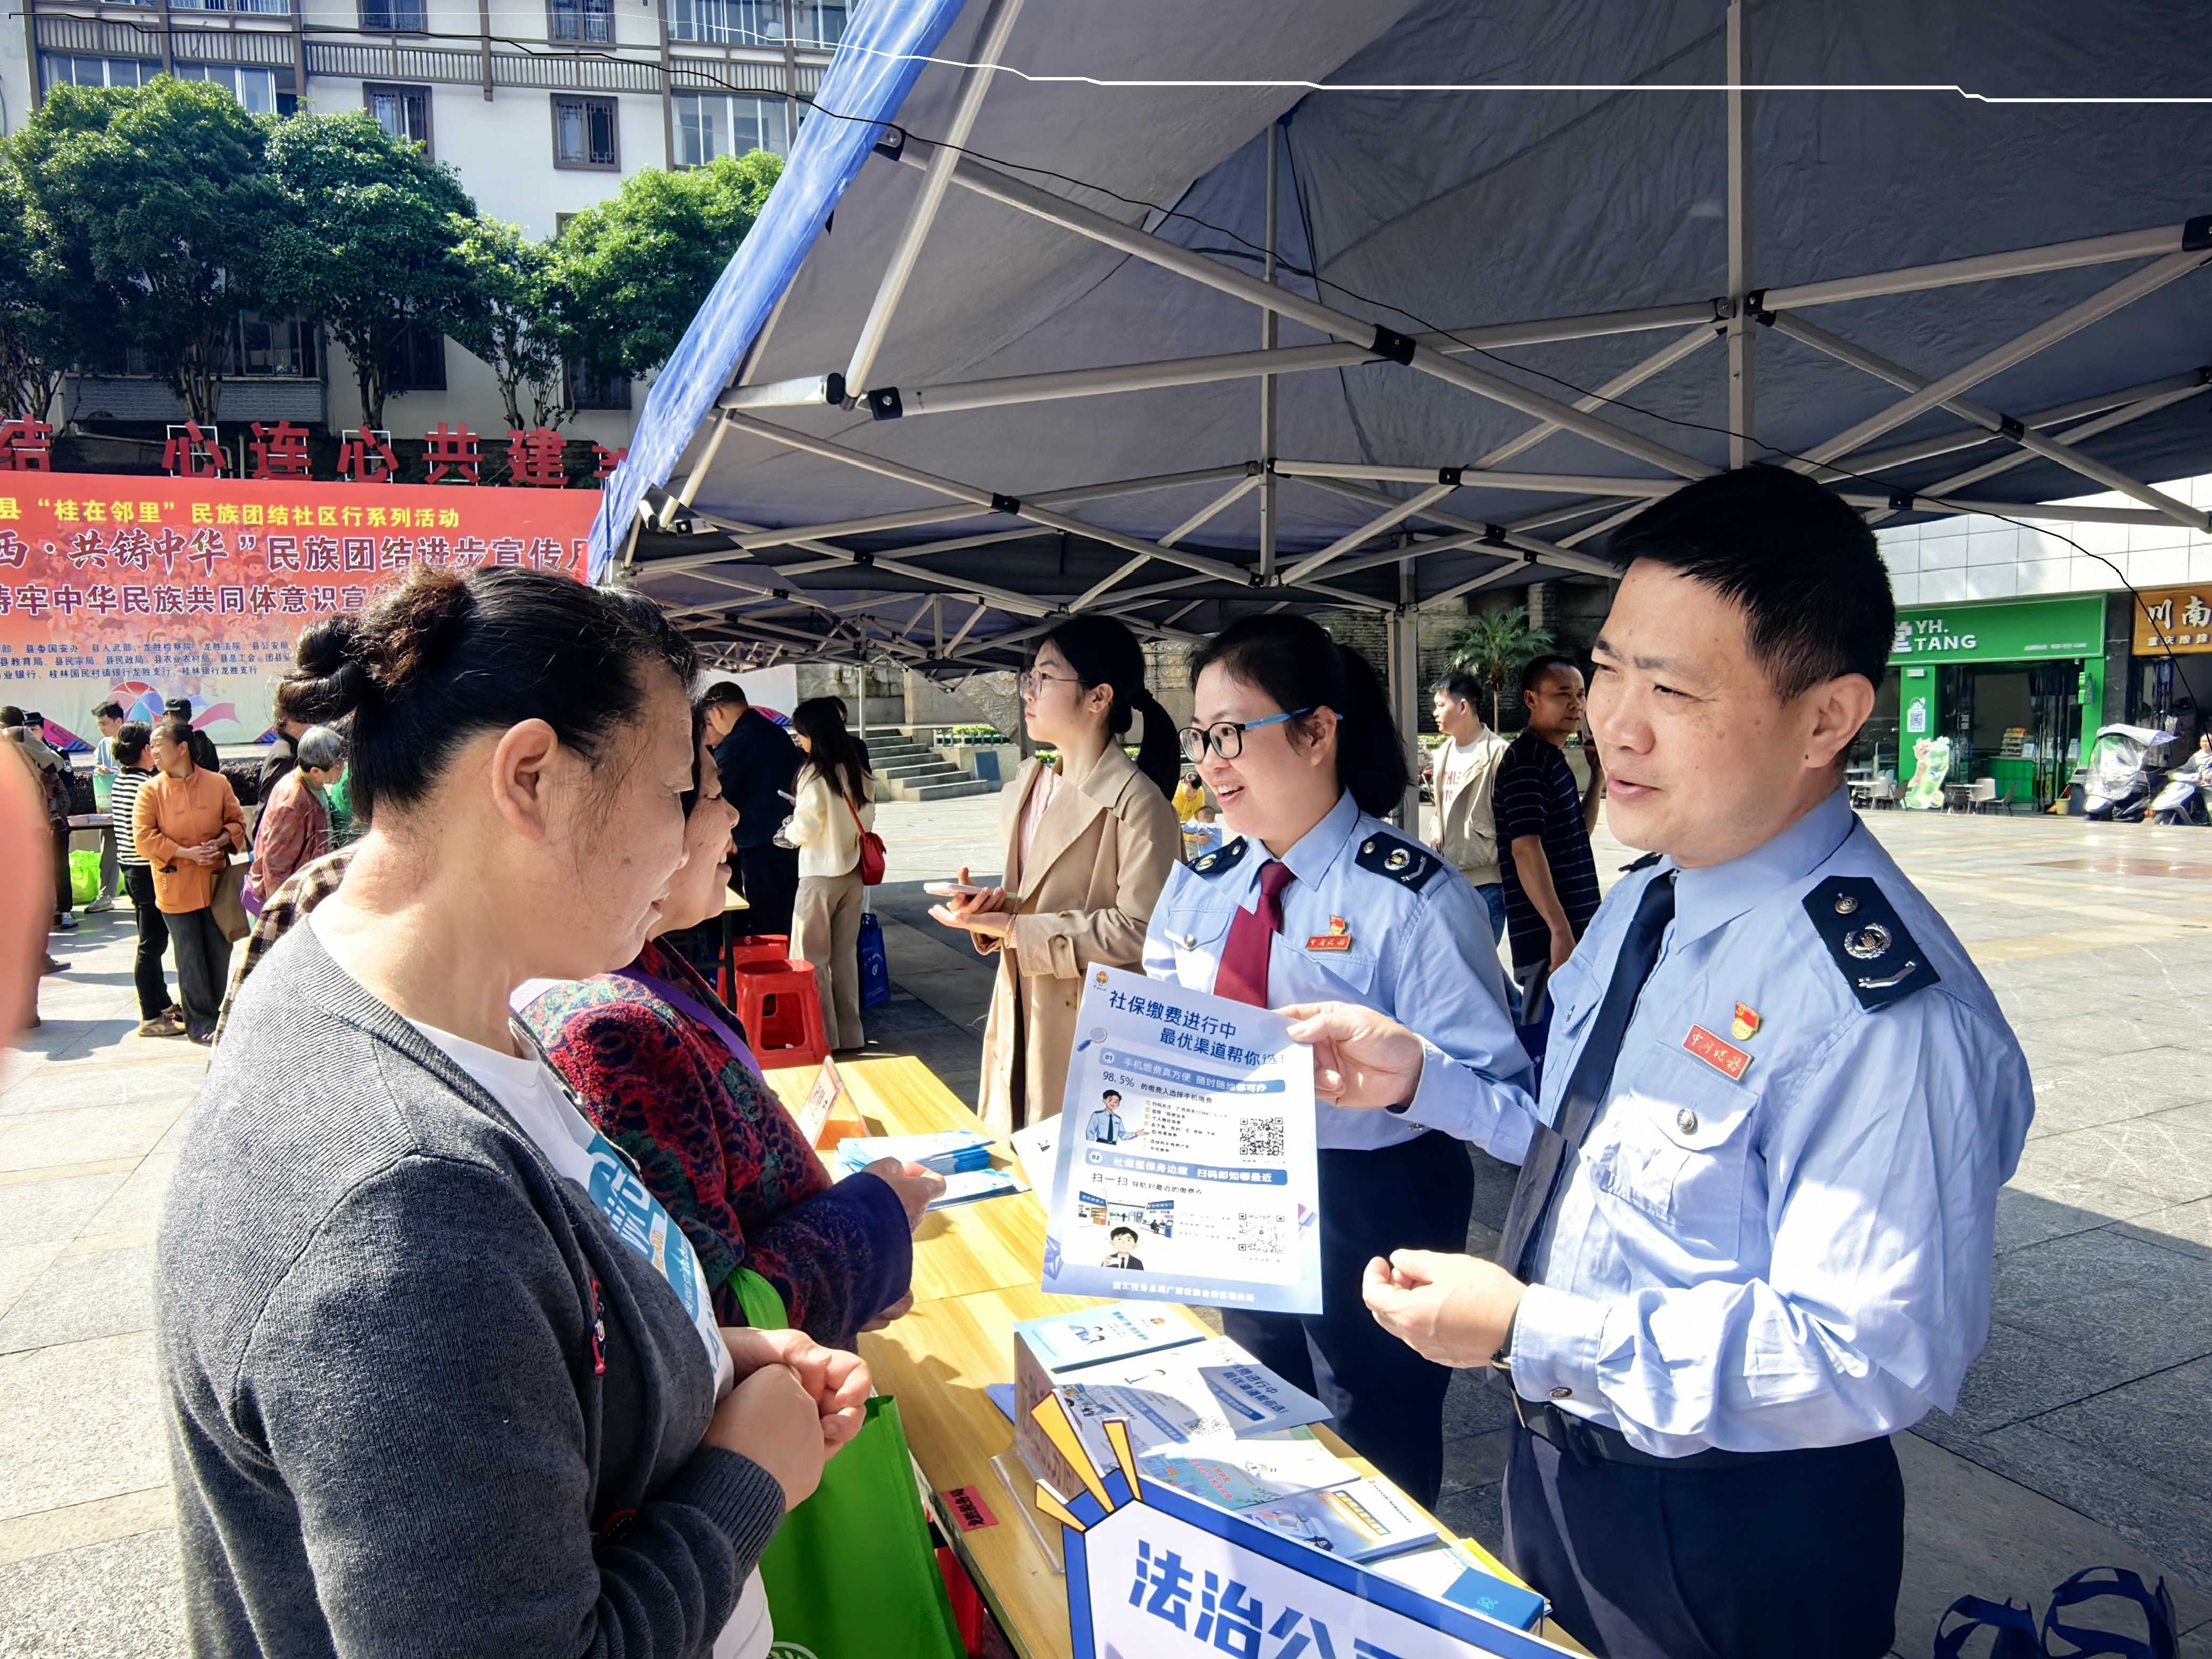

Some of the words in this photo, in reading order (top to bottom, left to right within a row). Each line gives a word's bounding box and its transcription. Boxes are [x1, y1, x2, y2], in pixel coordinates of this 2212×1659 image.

[0, 583, 390, 616] 牢中华民族共同体意识宣
[1915, 619, 1949, 634] YH.
[1915, 634, 1978, 651] TANG
[1109, 990, 1237, 1039] 社保缴费进行中
[1092, 1171, 1128, 1186] 扫一扫
[1128, 1538, 1404, 1659] 法治公
